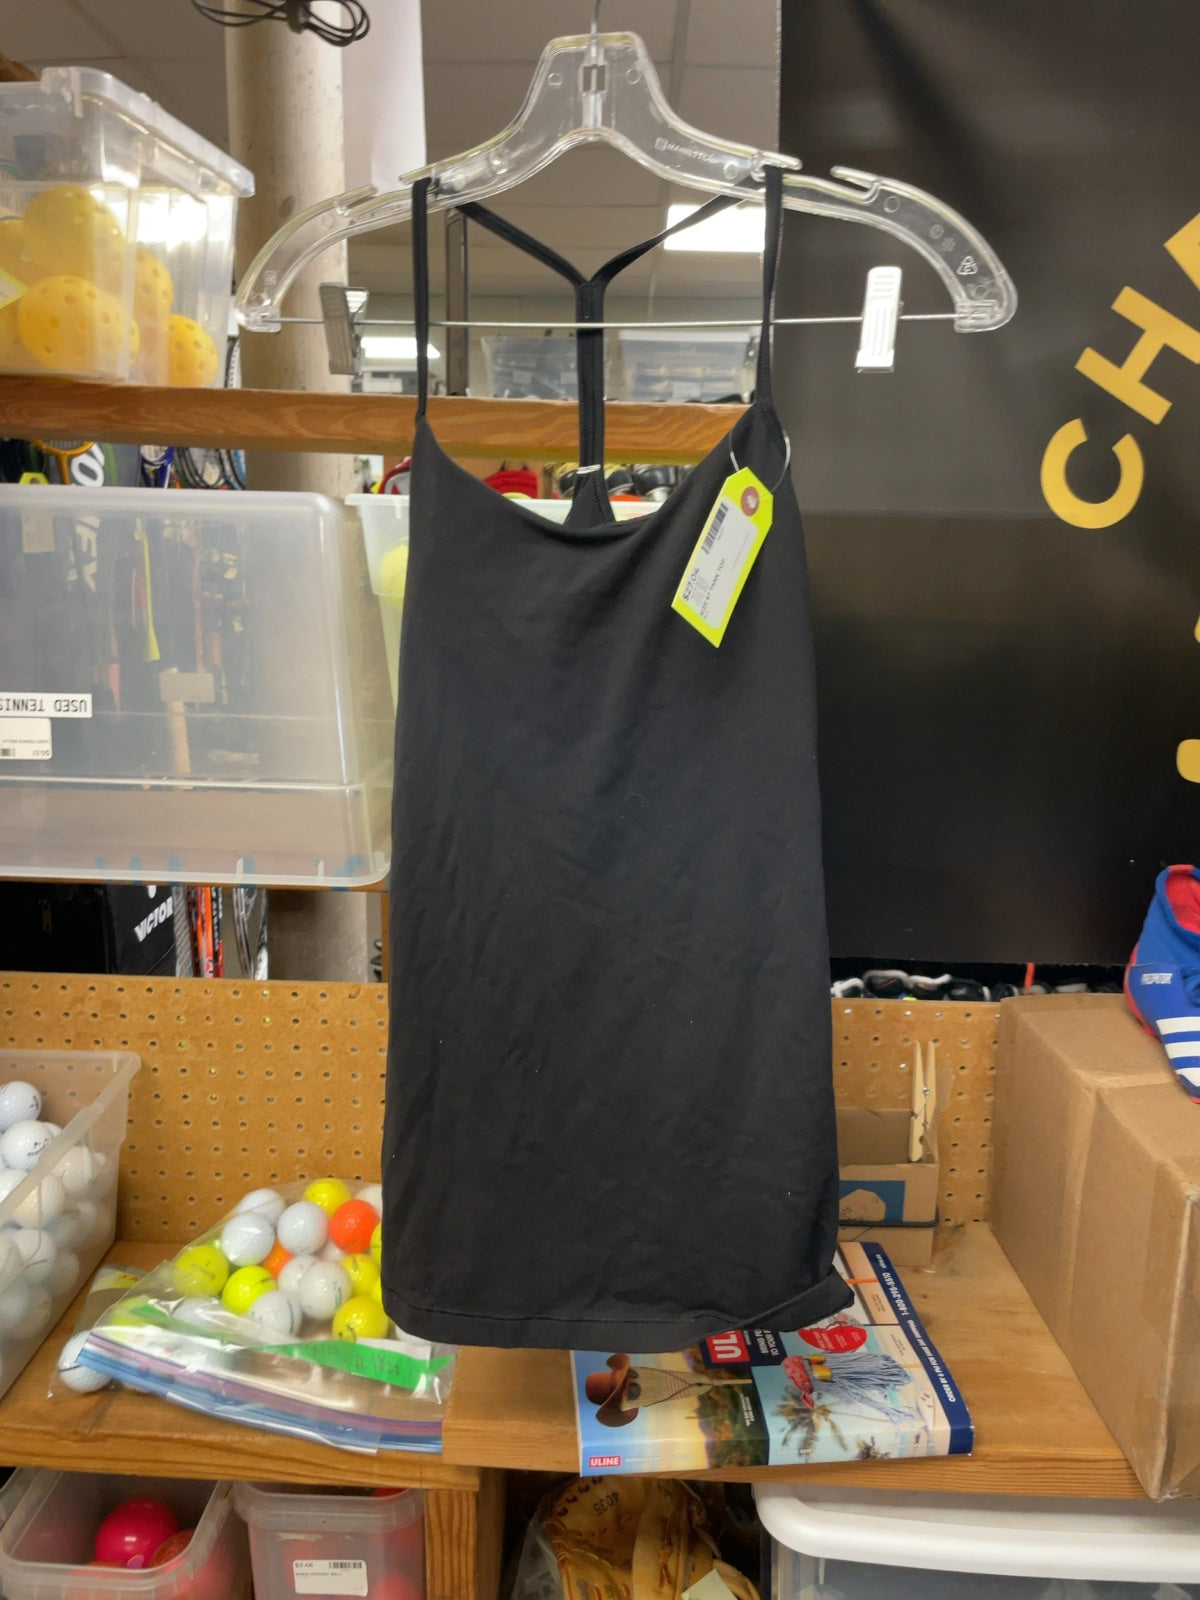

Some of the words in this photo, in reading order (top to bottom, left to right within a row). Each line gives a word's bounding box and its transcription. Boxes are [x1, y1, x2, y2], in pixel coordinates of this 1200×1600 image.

[1041, 213, 1200, 529] CH
[54, 699, 87, 713] USED
[133, 896, 174, 943] VICTOR
[945, 1385, 956, 1402] ORDER
[590, 1456, 620, 1467] ULINE
